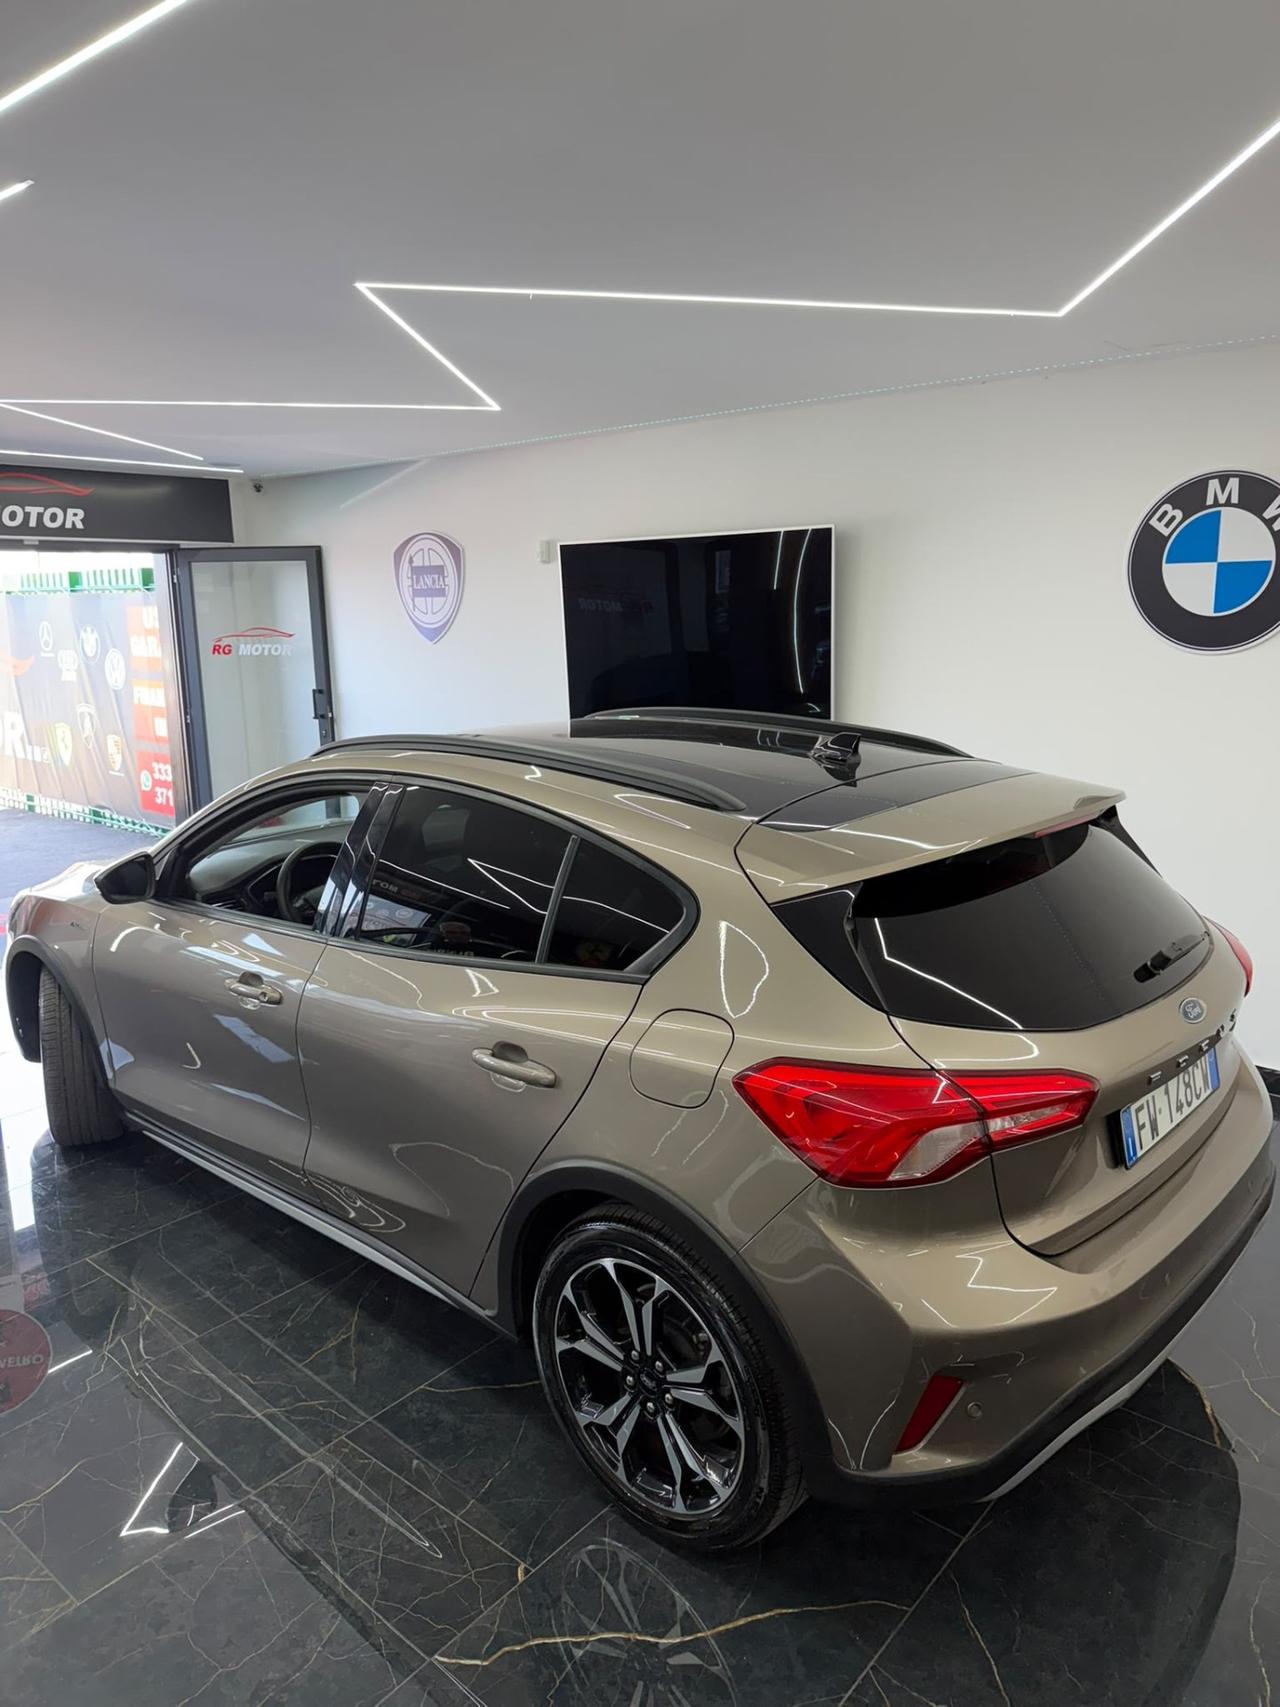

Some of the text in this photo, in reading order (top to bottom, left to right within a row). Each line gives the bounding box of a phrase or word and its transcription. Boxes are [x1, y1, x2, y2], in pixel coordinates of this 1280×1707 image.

[0, 504, 85, 529] OTOR
[413, 574, 445, 589] LANCIA
[212, 643, 292, 656] RG MOTOR
[1134, 1094, 1160, 1150] FW
